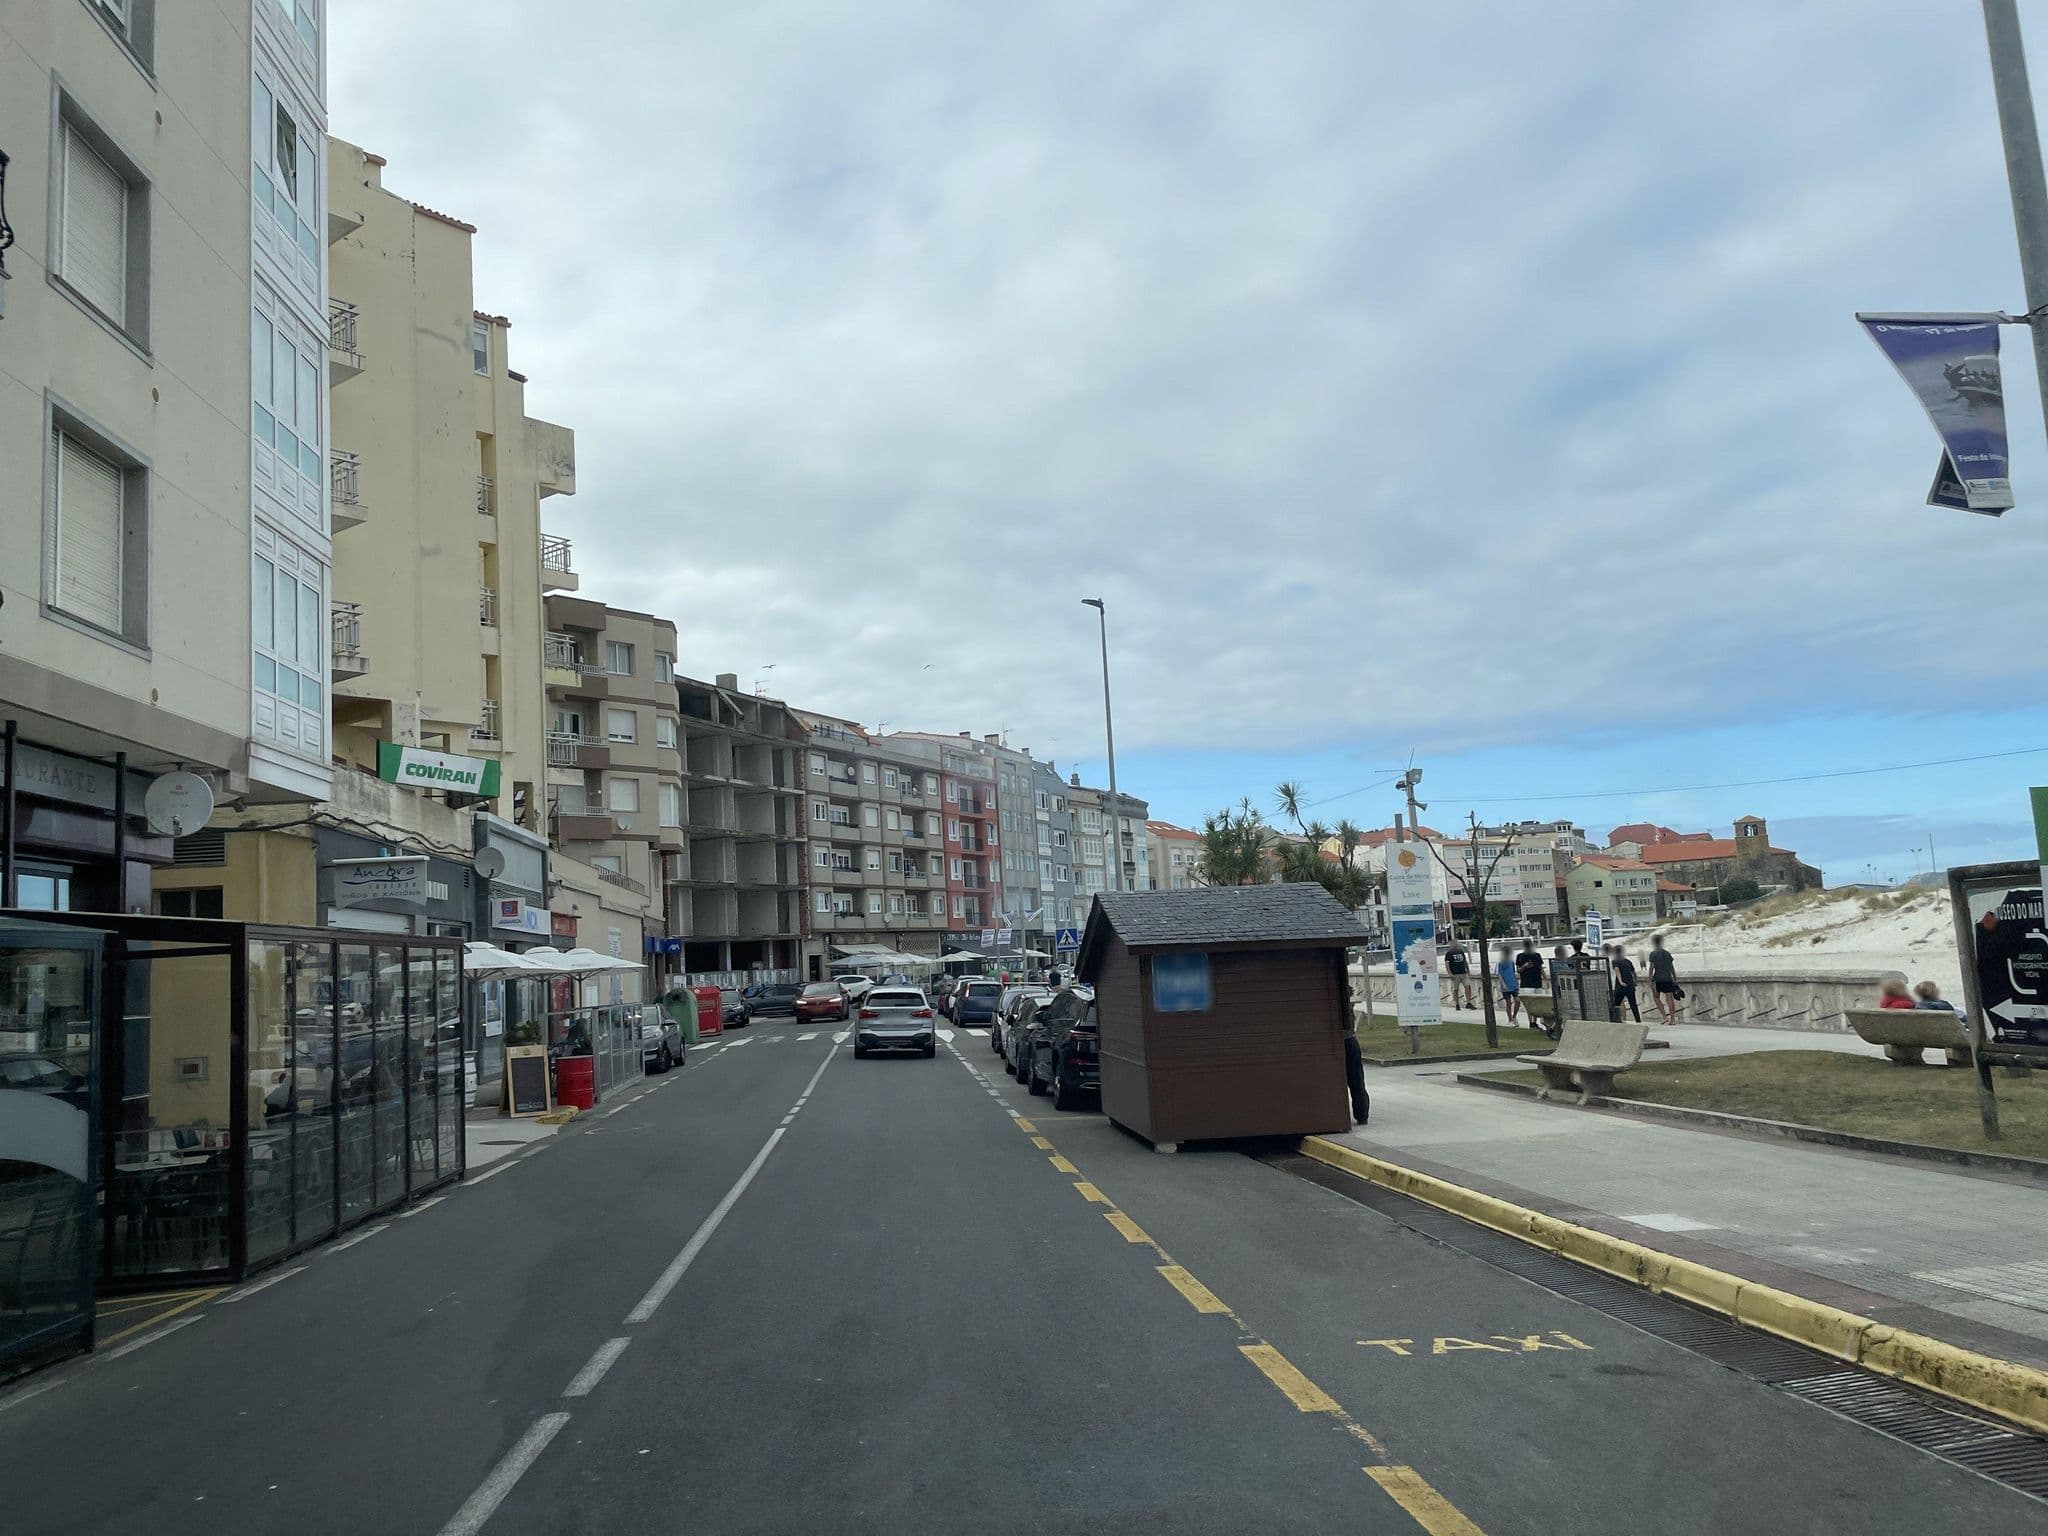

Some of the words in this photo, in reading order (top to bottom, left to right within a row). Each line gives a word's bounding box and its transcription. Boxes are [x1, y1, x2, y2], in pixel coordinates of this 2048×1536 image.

[405, 761, 477, 785] COVIRAN
[2016, 902, 2028, 920] DO
[1357, 1330, 1596, 1356] TAXI
